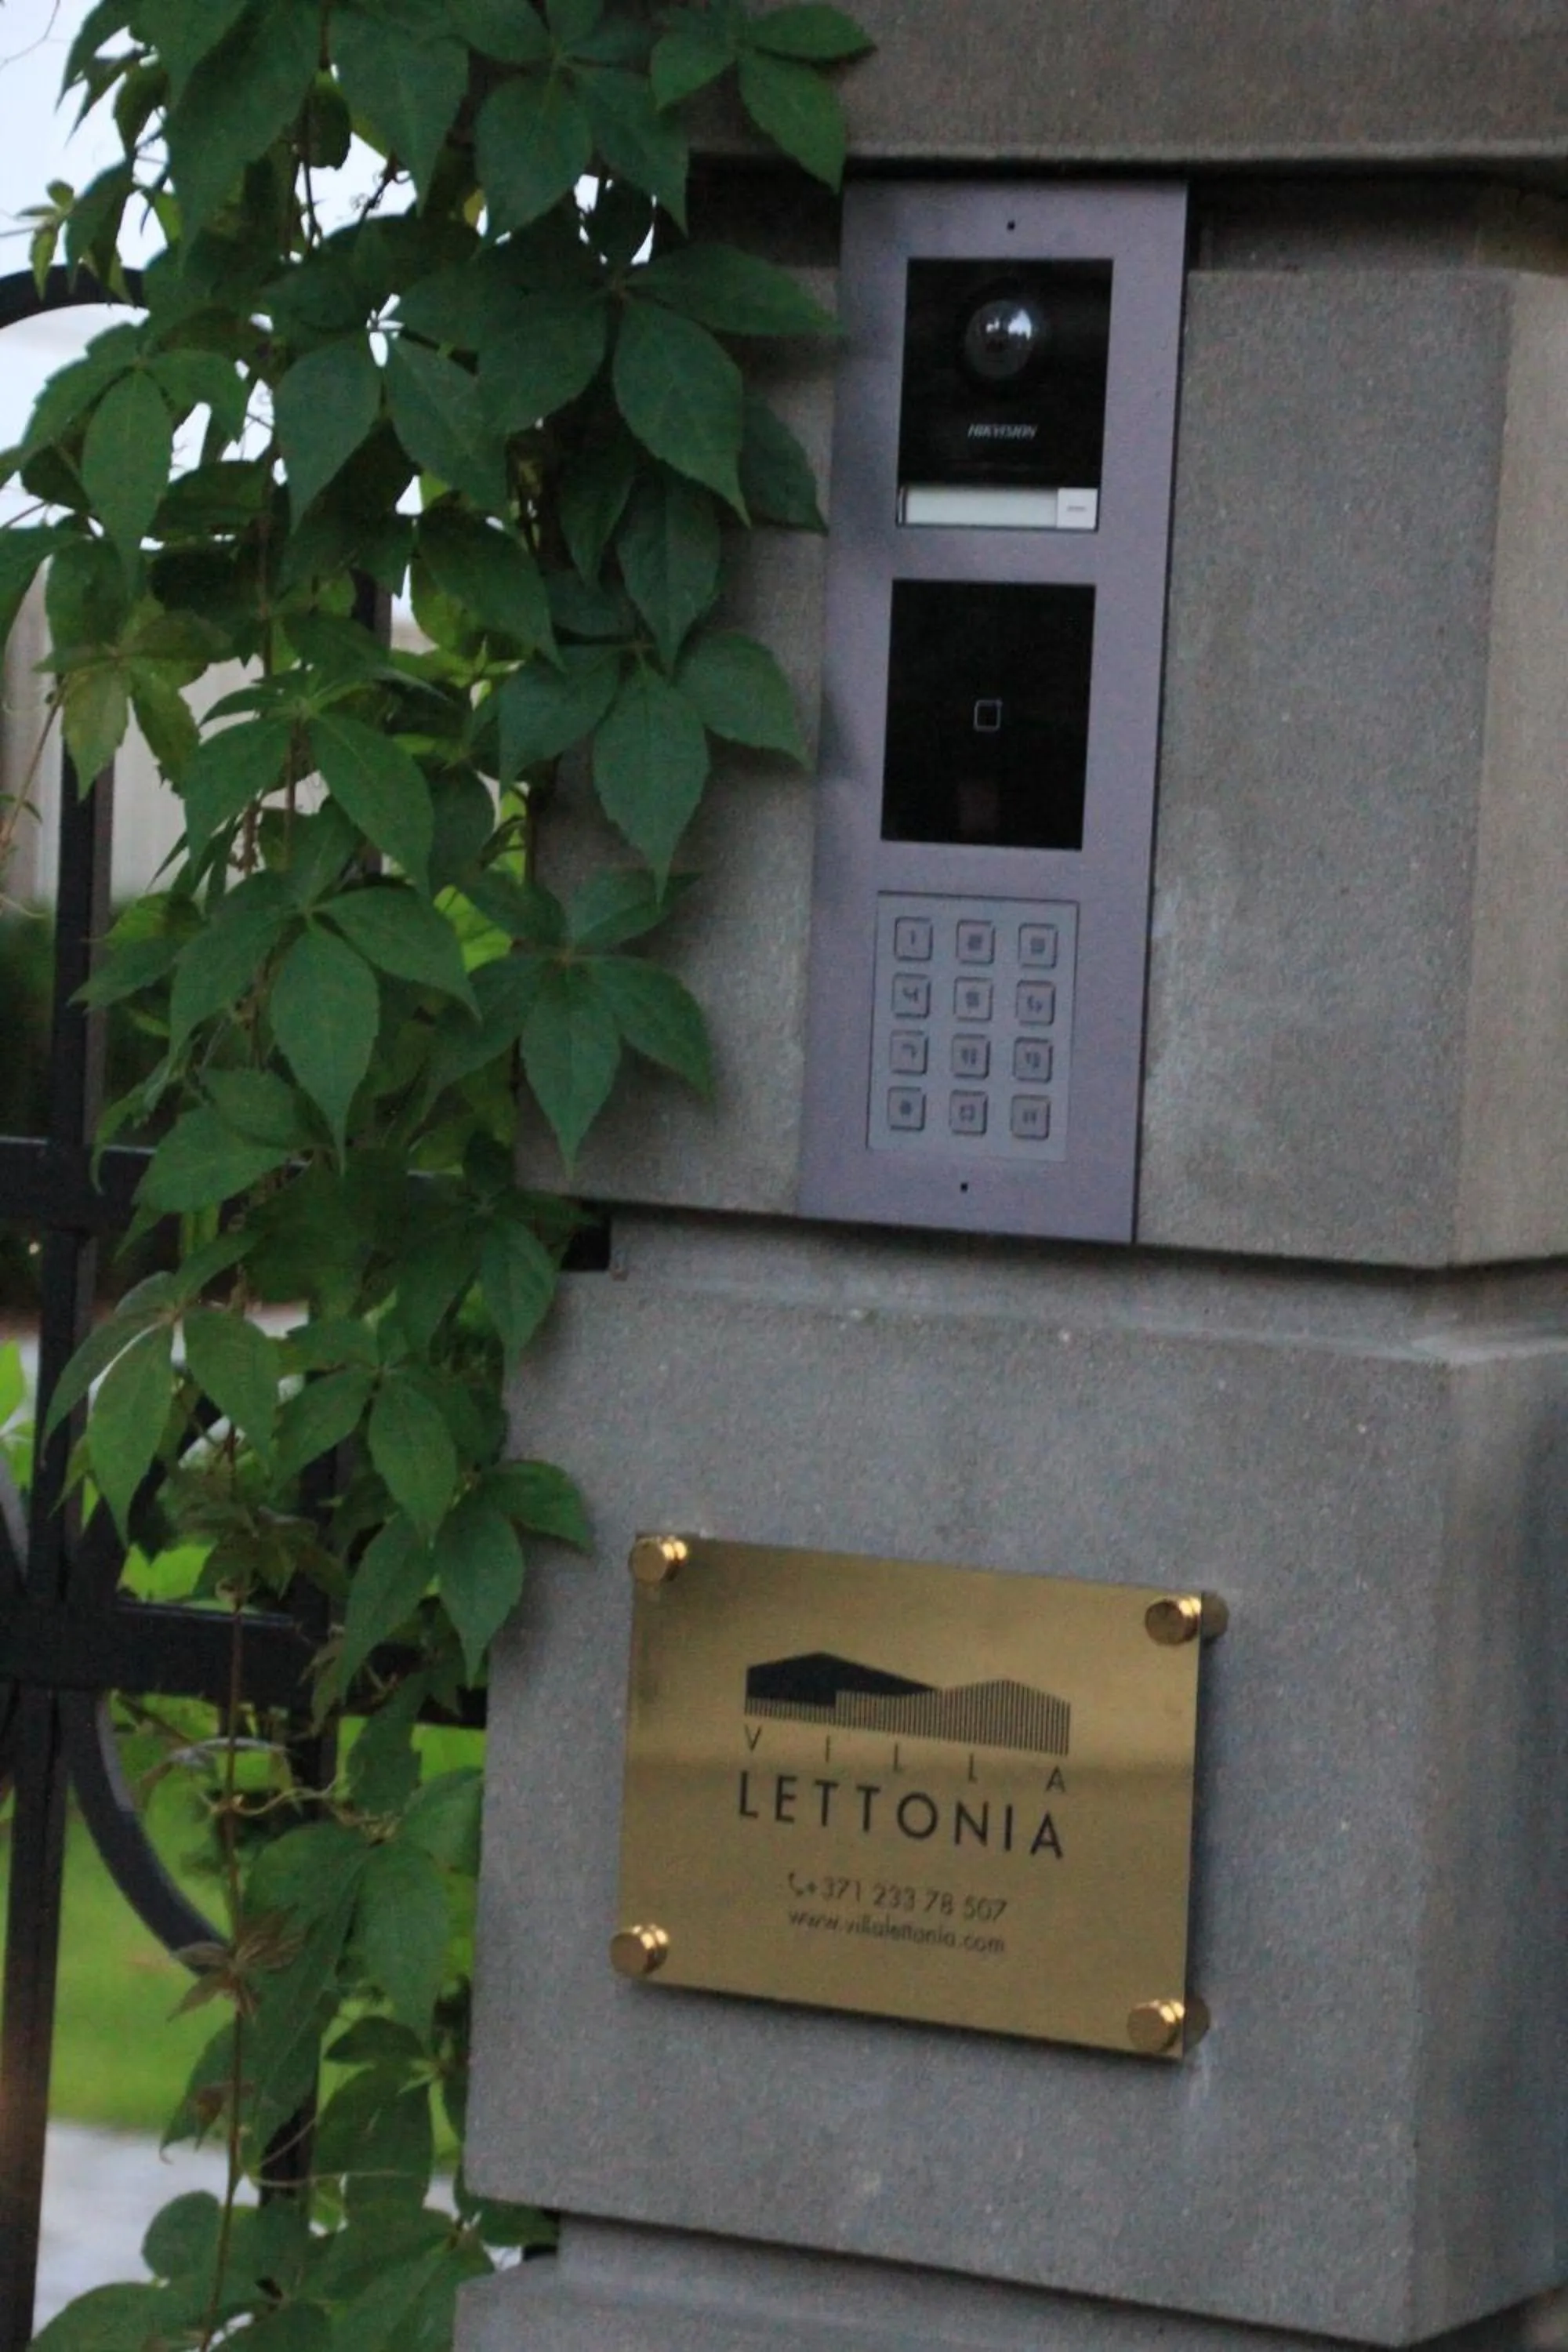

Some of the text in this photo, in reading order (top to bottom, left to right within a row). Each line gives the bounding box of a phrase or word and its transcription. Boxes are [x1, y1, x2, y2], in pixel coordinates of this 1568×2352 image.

[744, 1725, 1065, 1793] VILLA
[739, 1769, 1064, 1859] LETTONIA
[873, 1882, 916, 1911] 233
[924, 1889, 953, 1915] 78
[963, 1894, 1008, 1921] 507
